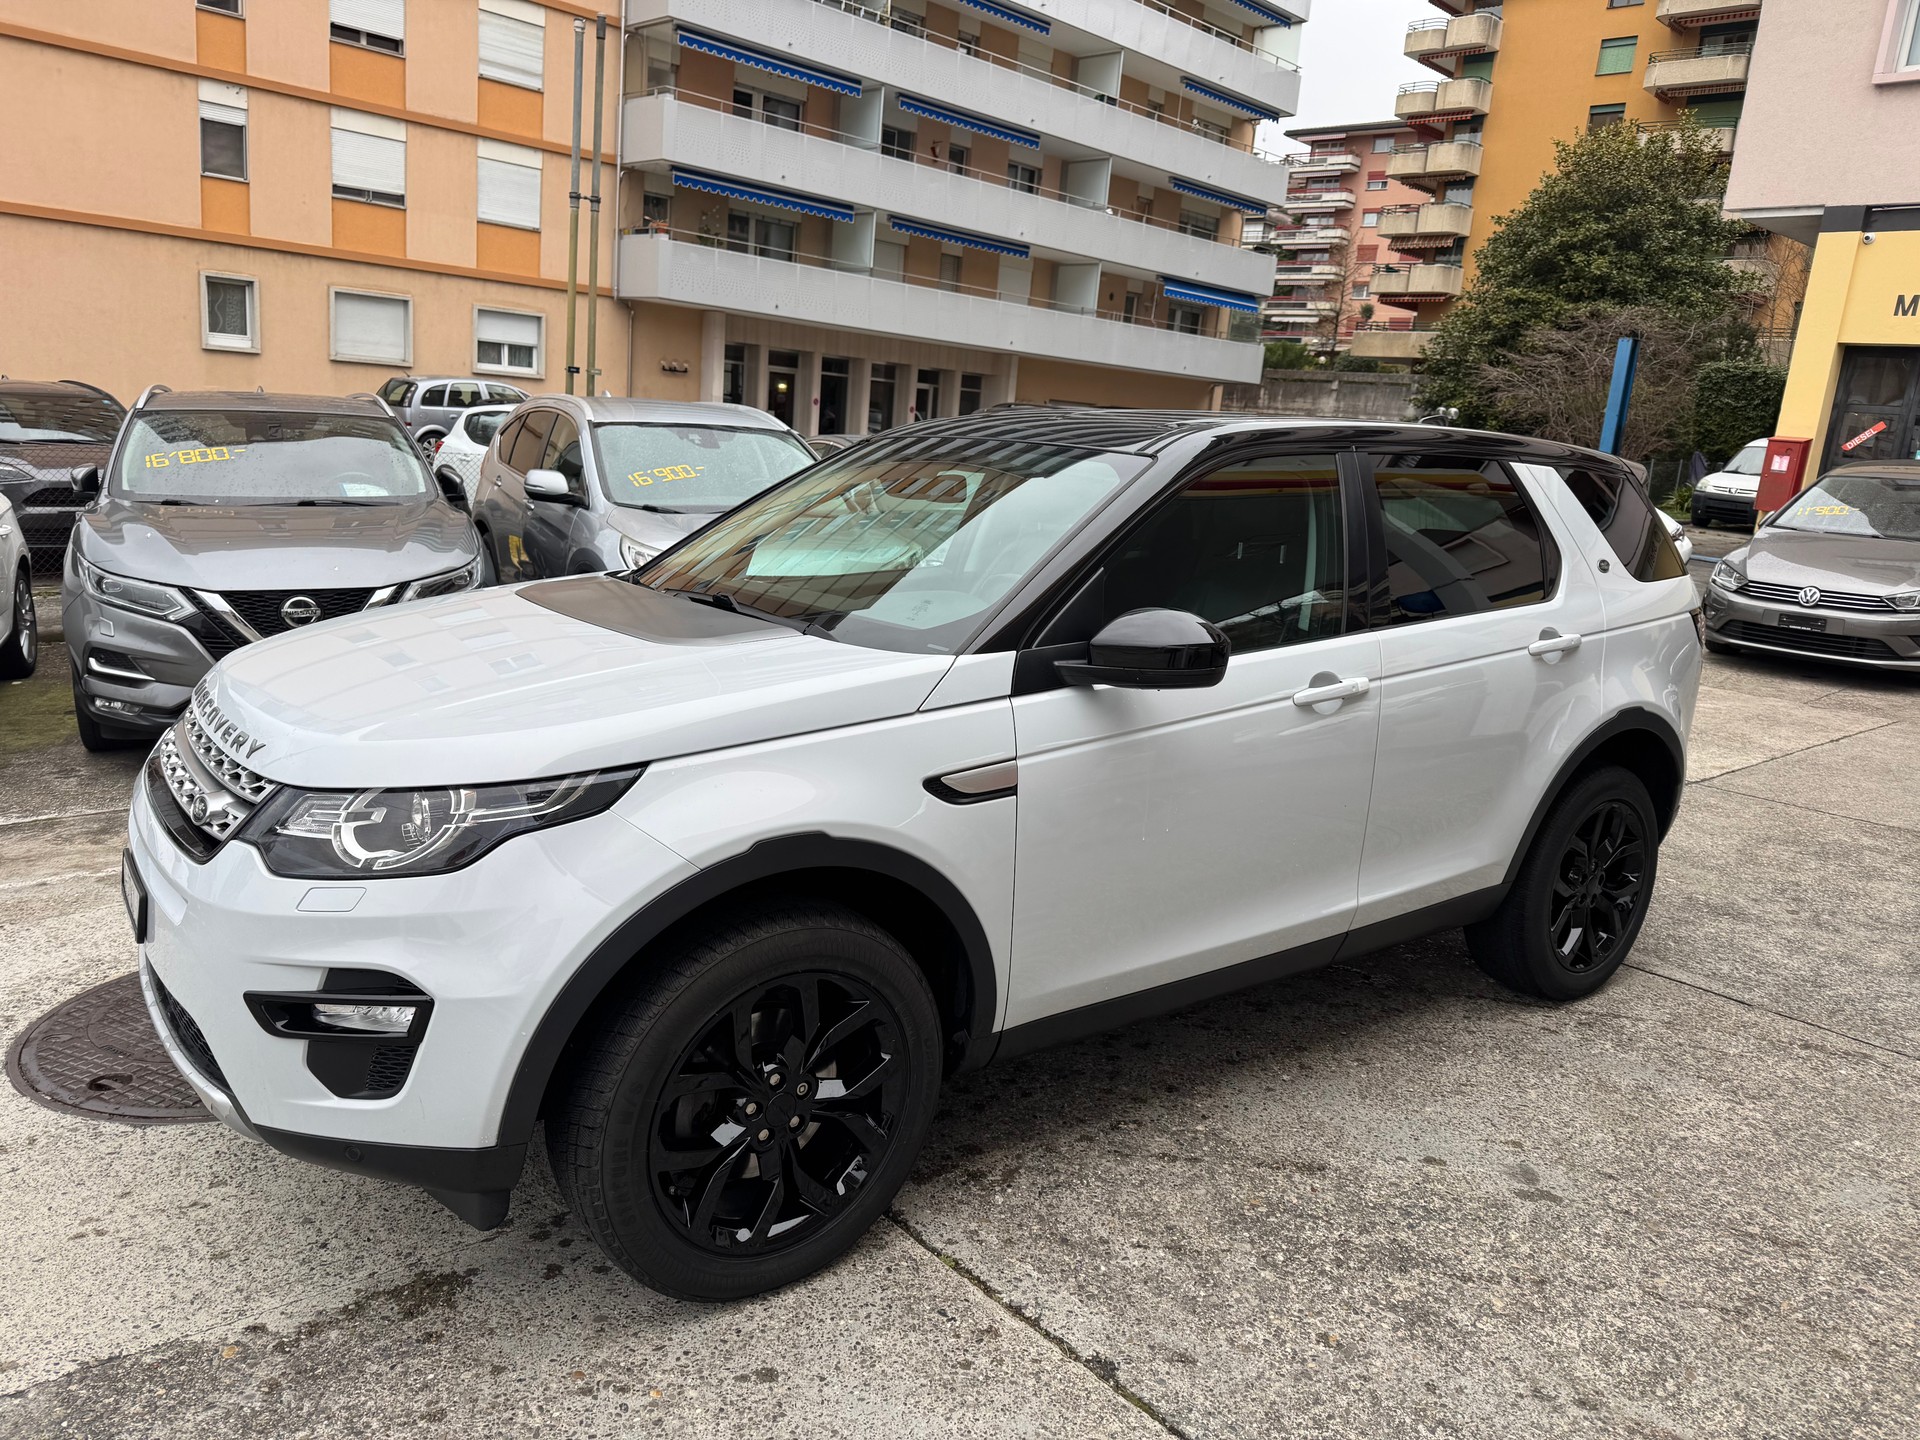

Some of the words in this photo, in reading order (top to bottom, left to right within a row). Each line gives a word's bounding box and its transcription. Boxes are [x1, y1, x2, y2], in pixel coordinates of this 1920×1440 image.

[1846, 428, 1879, 449] DIESEL
[285, 609, 317, 617] NISSAN
[193, 678, 267, 760] DISCOVERY
